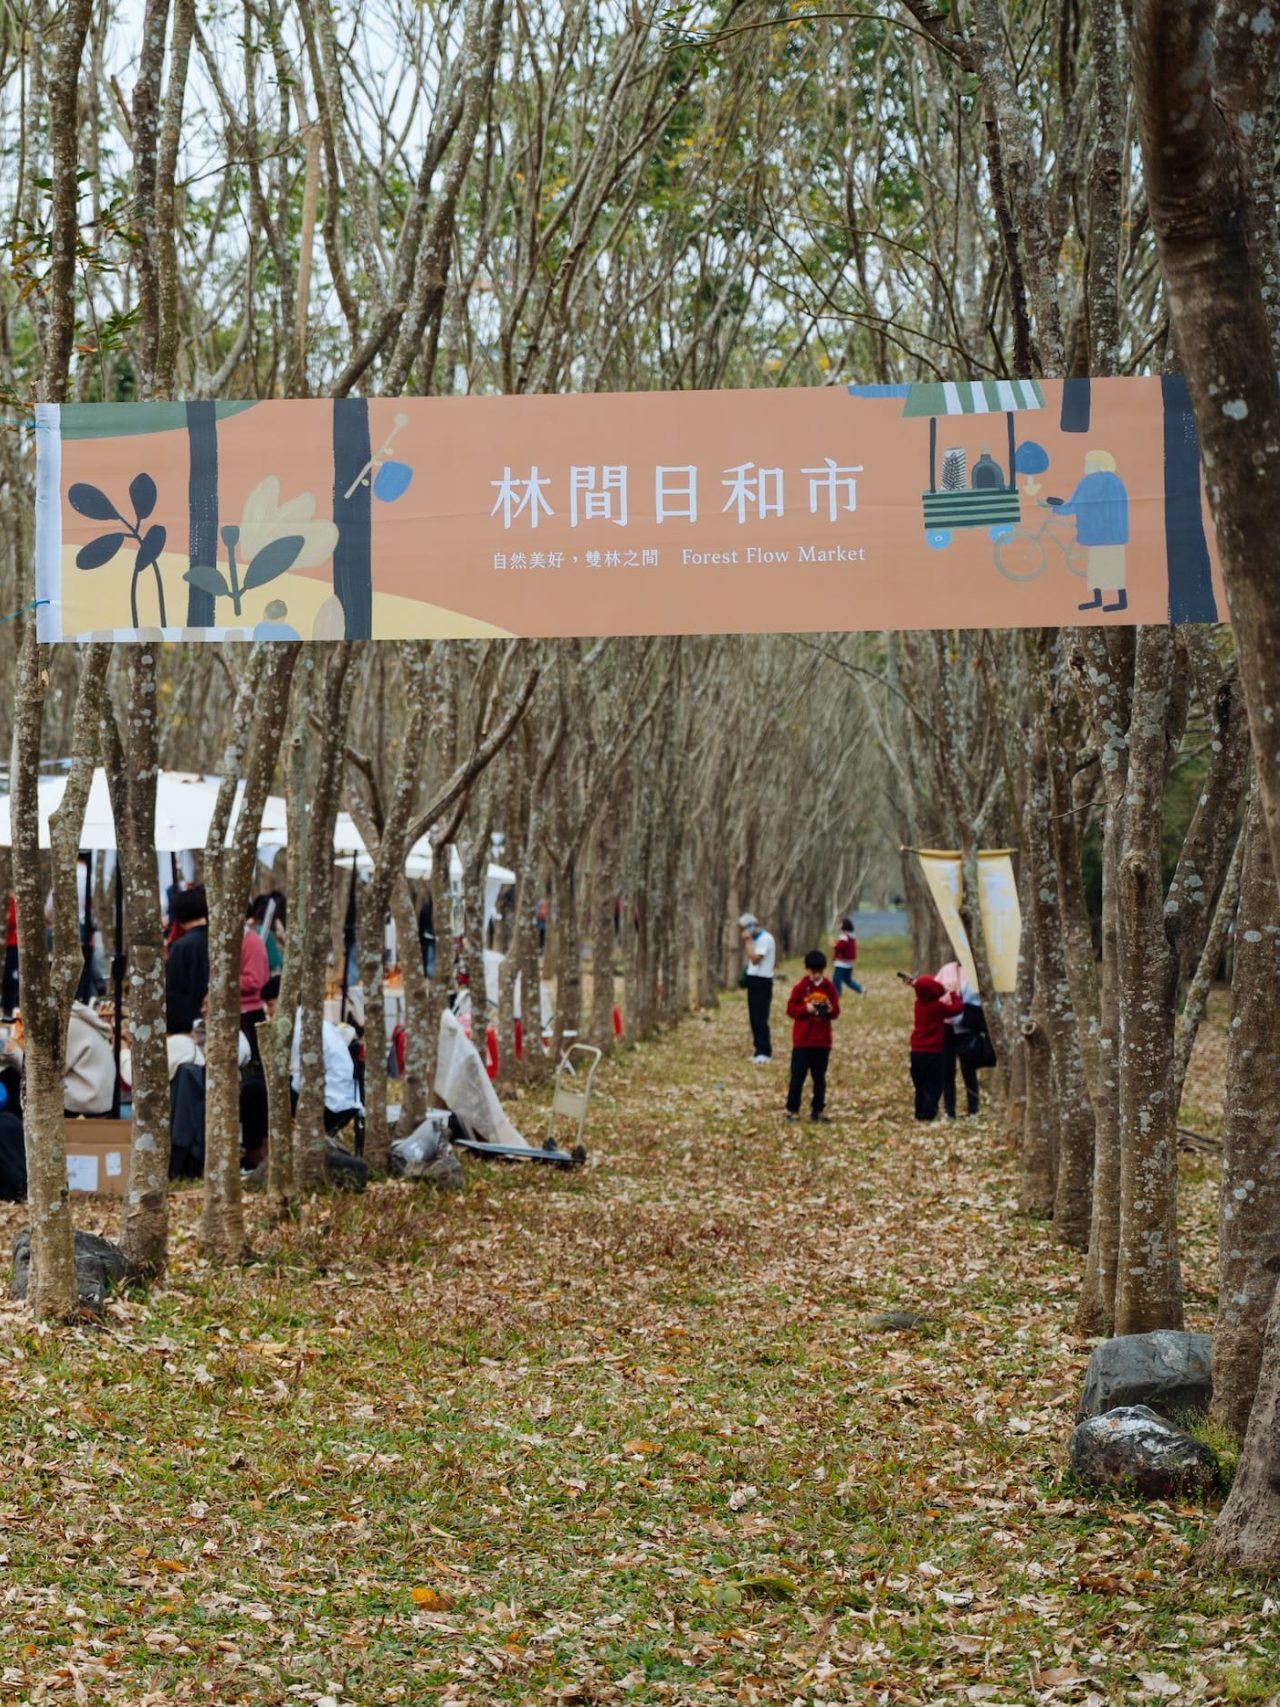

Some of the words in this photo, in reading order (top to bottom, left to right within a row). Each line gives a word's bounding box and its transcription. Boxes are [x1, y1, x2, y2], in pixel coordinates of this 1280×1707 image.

[490, 457, 864, 529] 林間日和市
[682, 548, 738, 565] Forest
[746, 545, 789, 563] Flow
[798, 545, 866, 563] Market
